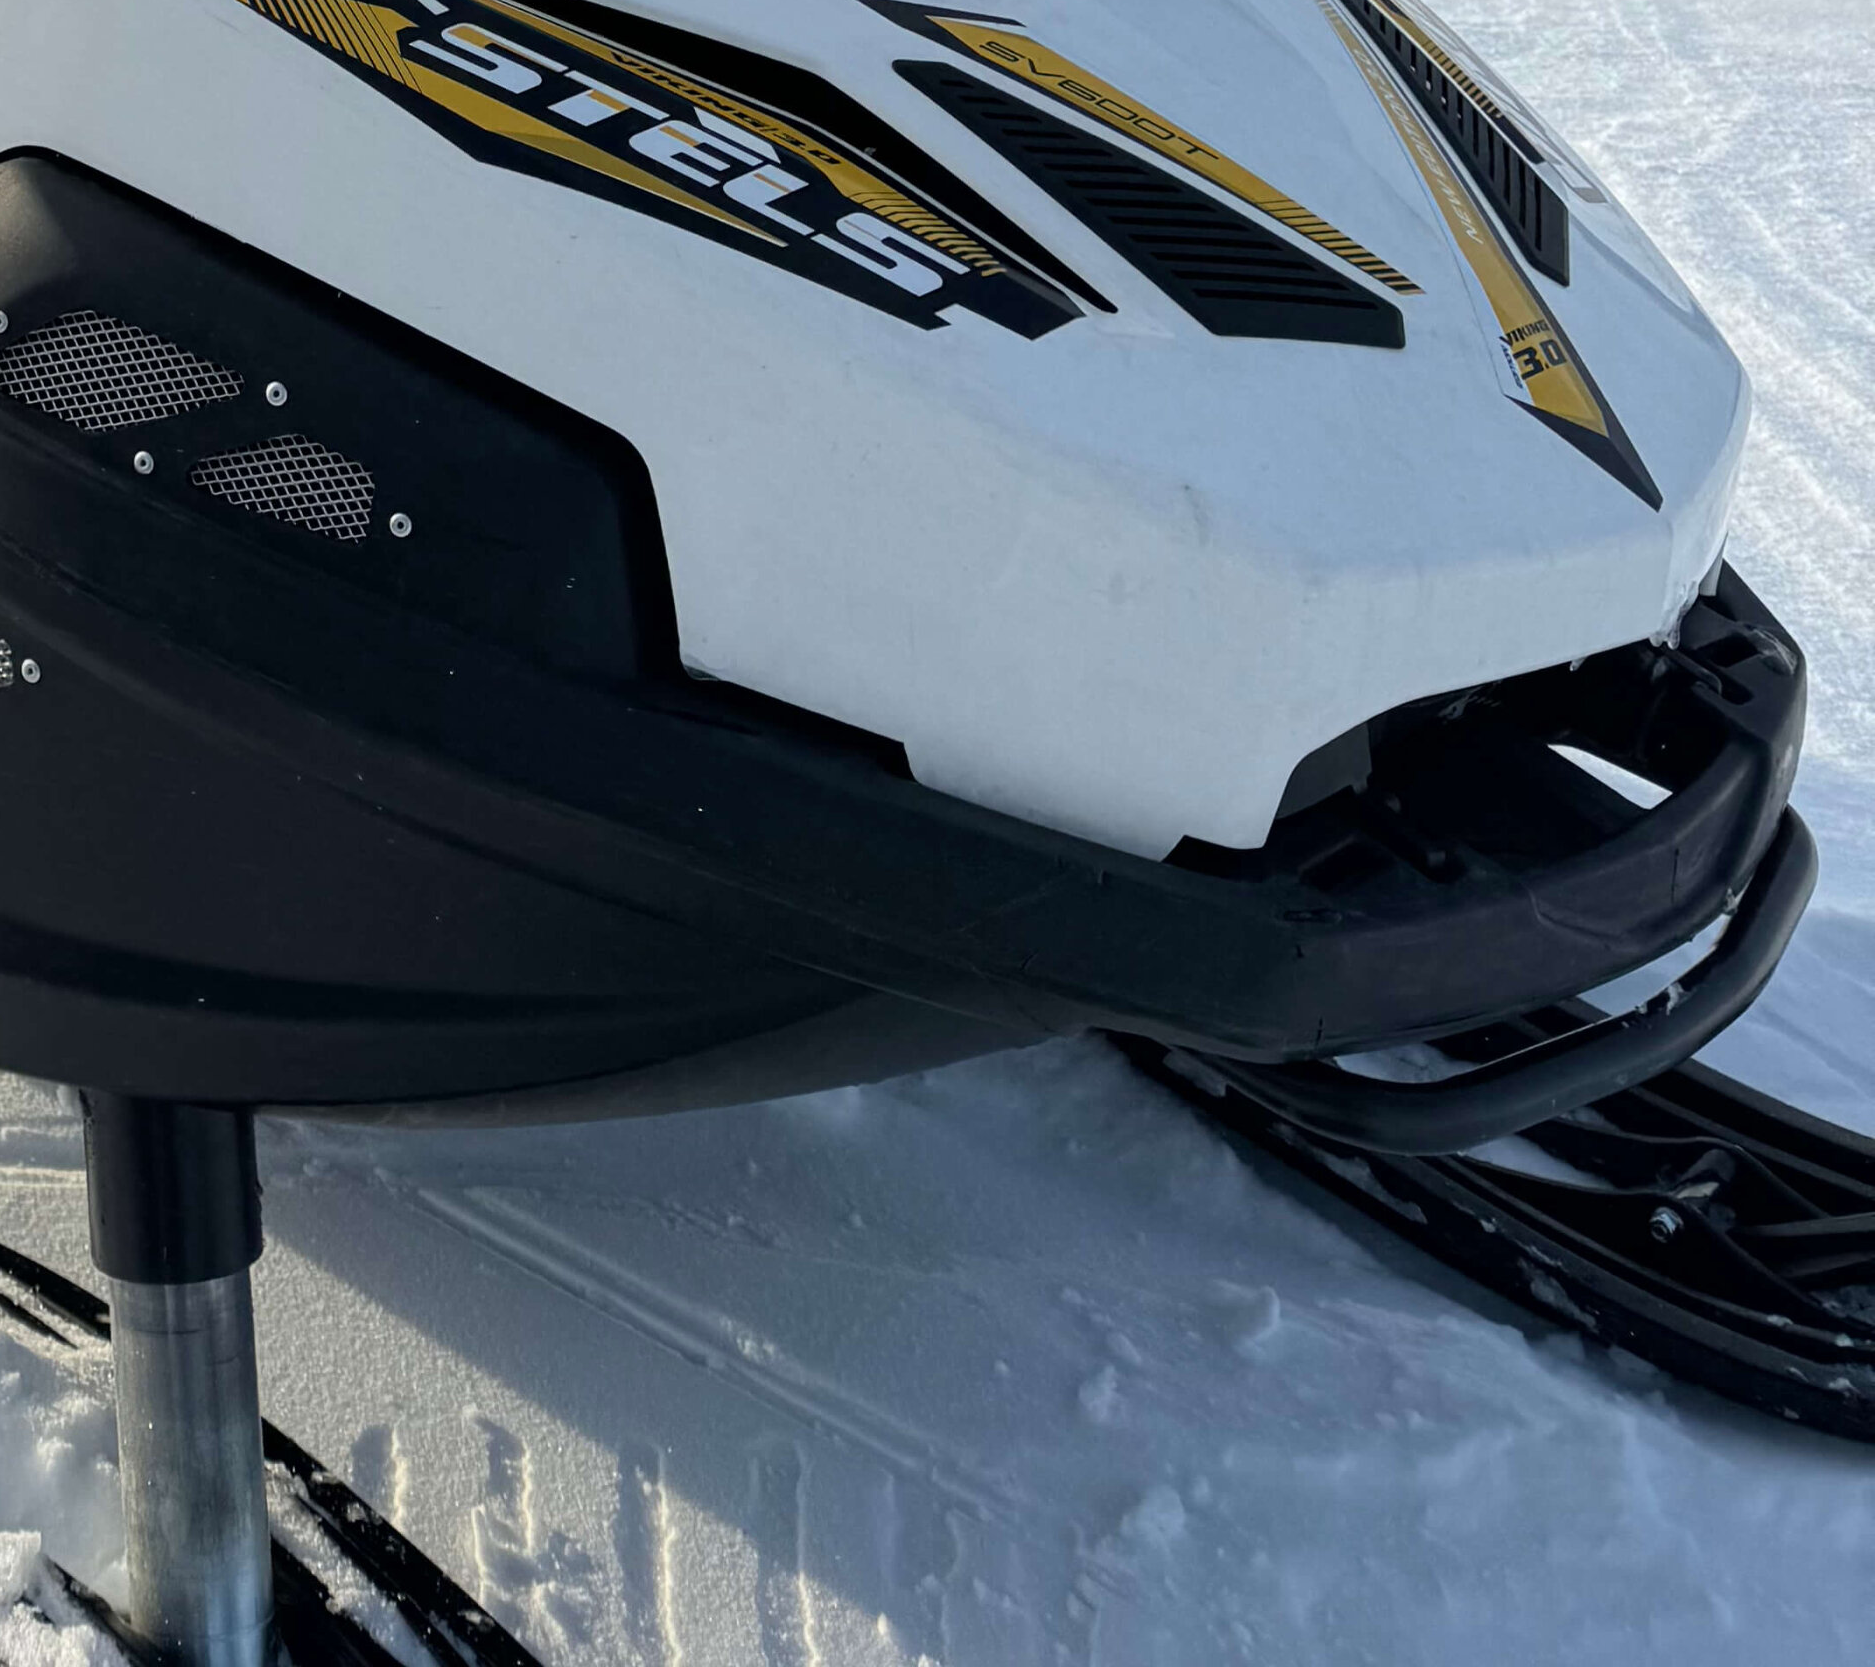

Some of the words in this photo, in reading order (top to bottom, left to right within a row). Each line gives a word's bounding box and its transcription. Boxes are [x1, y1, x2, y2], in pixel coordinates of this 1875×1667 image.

[979, 40, 1220, 160] SV600T
[409, 22, 971, 297] STELS
[1498, 319, 1551, 347] VIKING
[1512, 338, 1568, 381] 3.0
